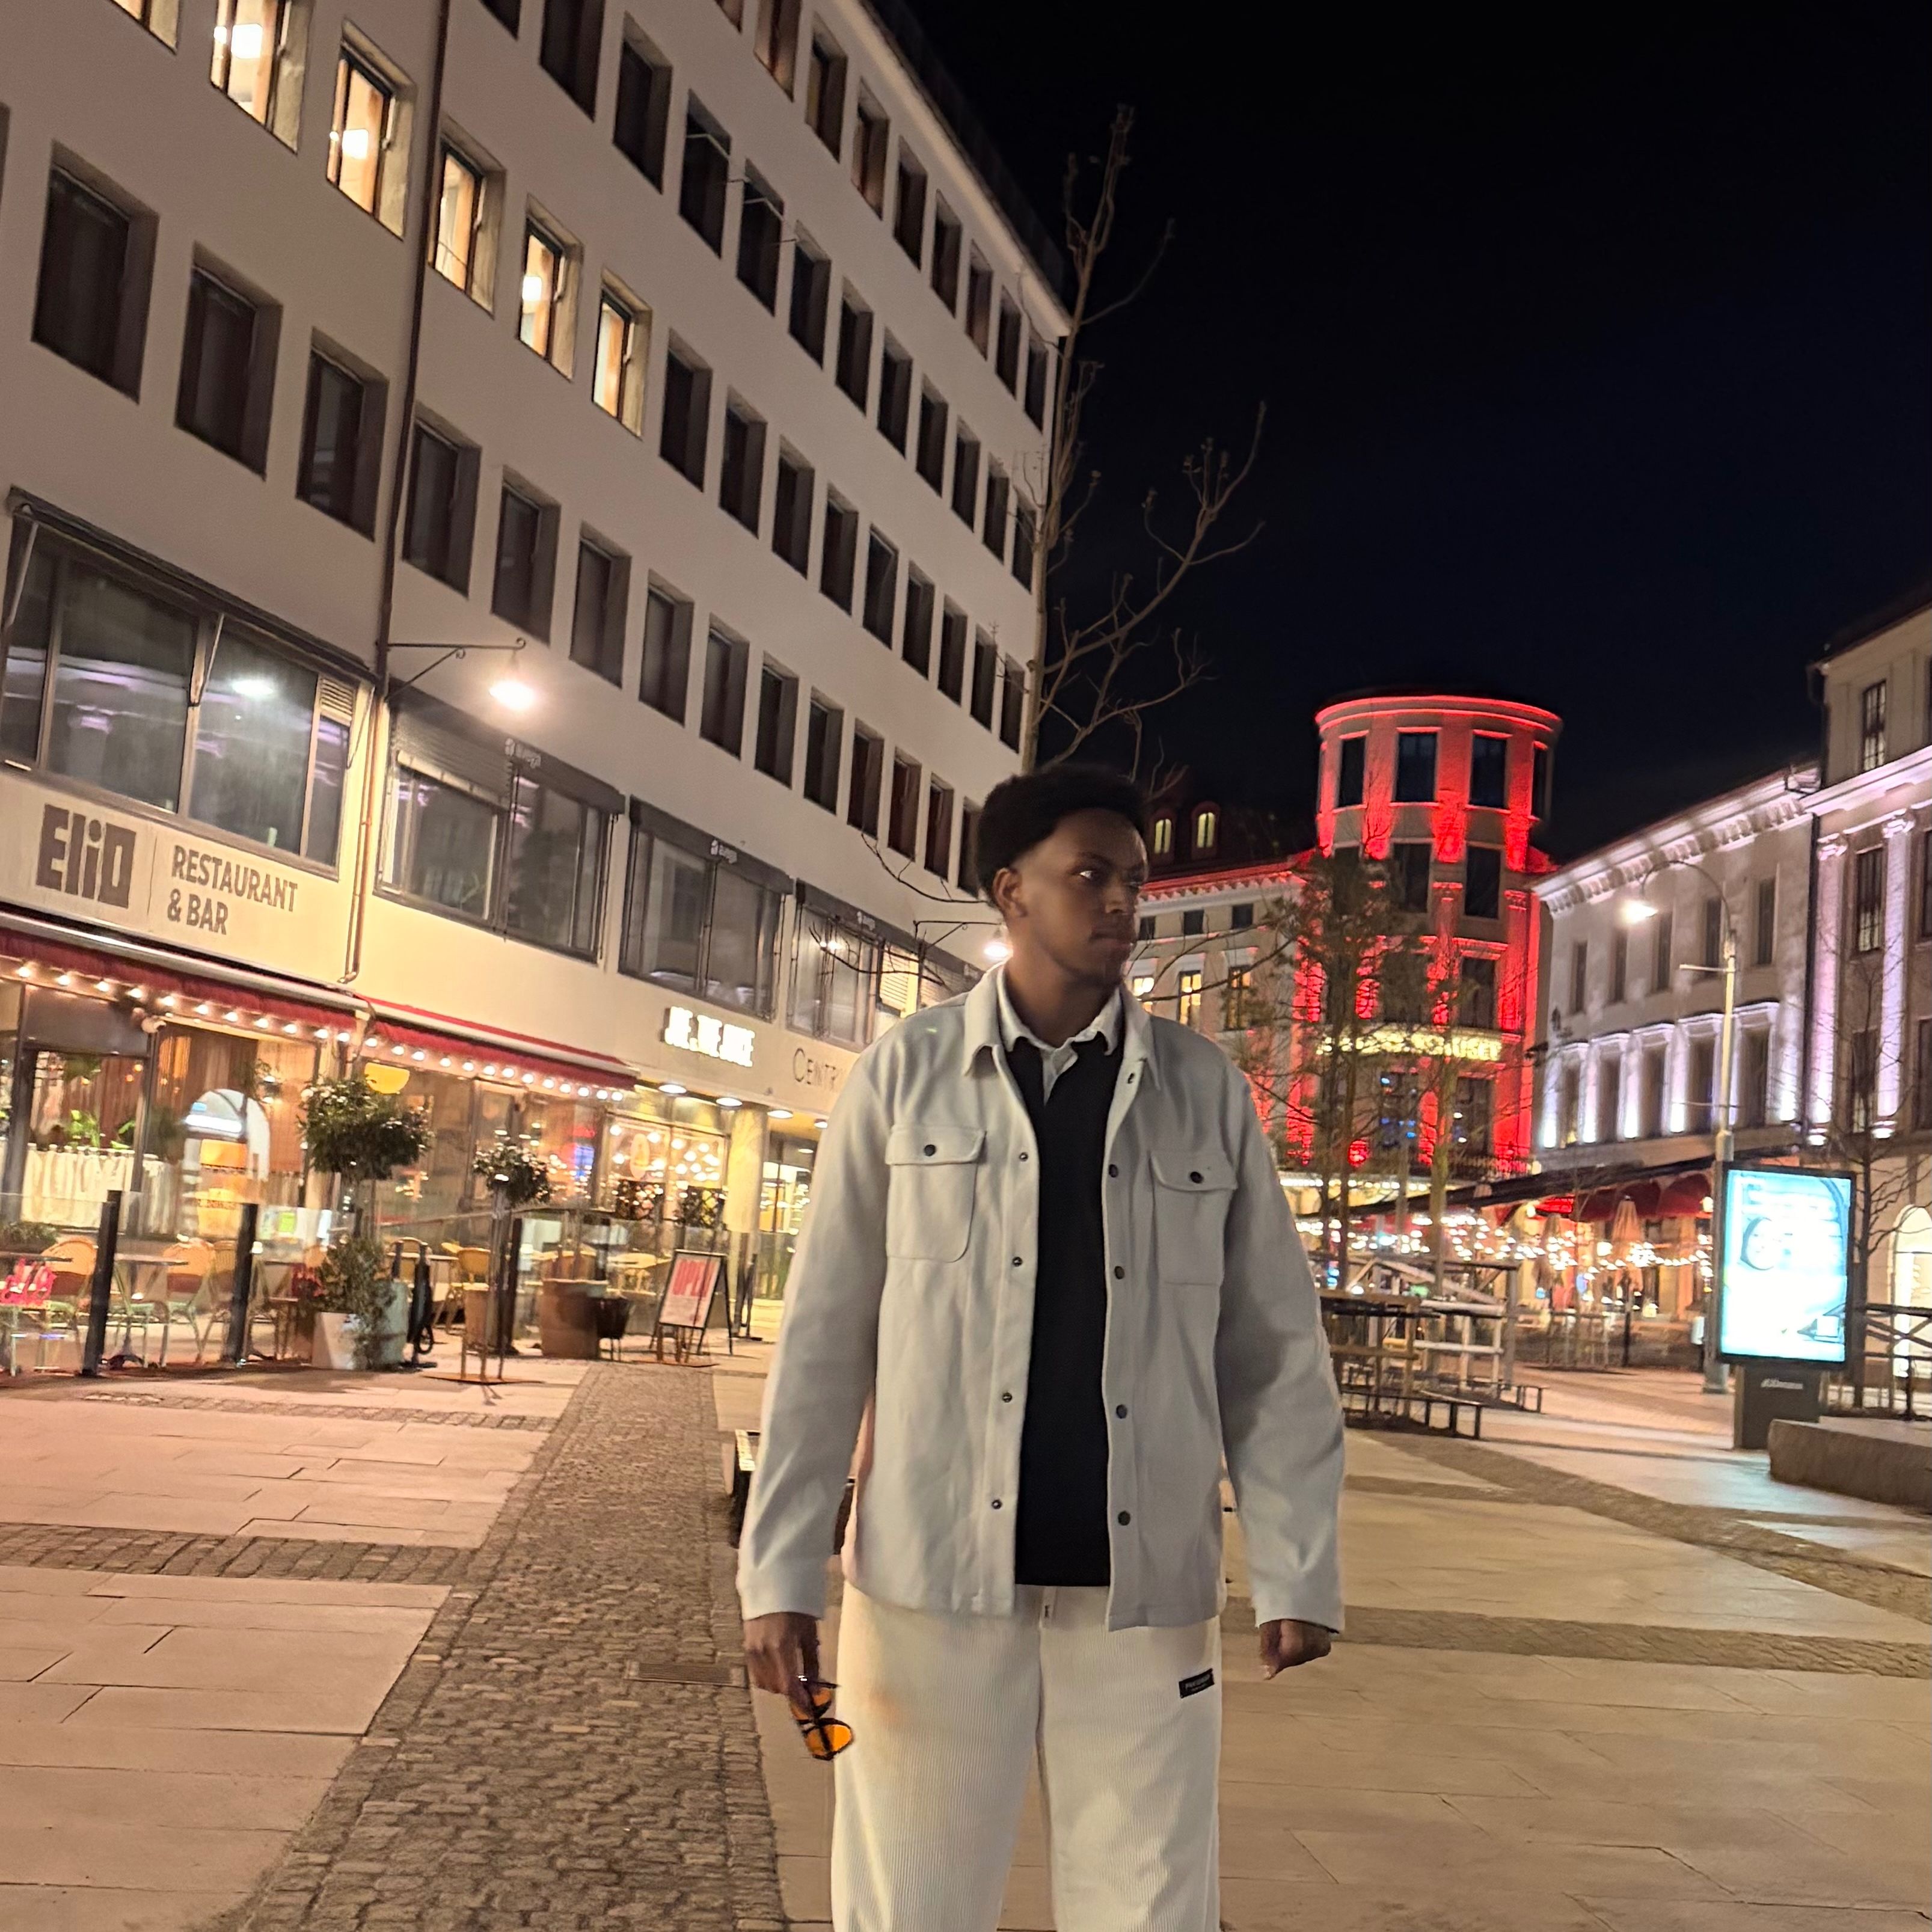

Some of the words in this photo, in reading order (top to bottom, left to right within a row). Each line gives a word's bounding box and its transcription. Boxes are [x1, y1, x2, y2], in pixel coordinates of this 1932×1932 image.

[171, 845, 298, 912] RESTAURANT
[167, 888, 182, 923] &
[186, 894, 228, 935] BAR
